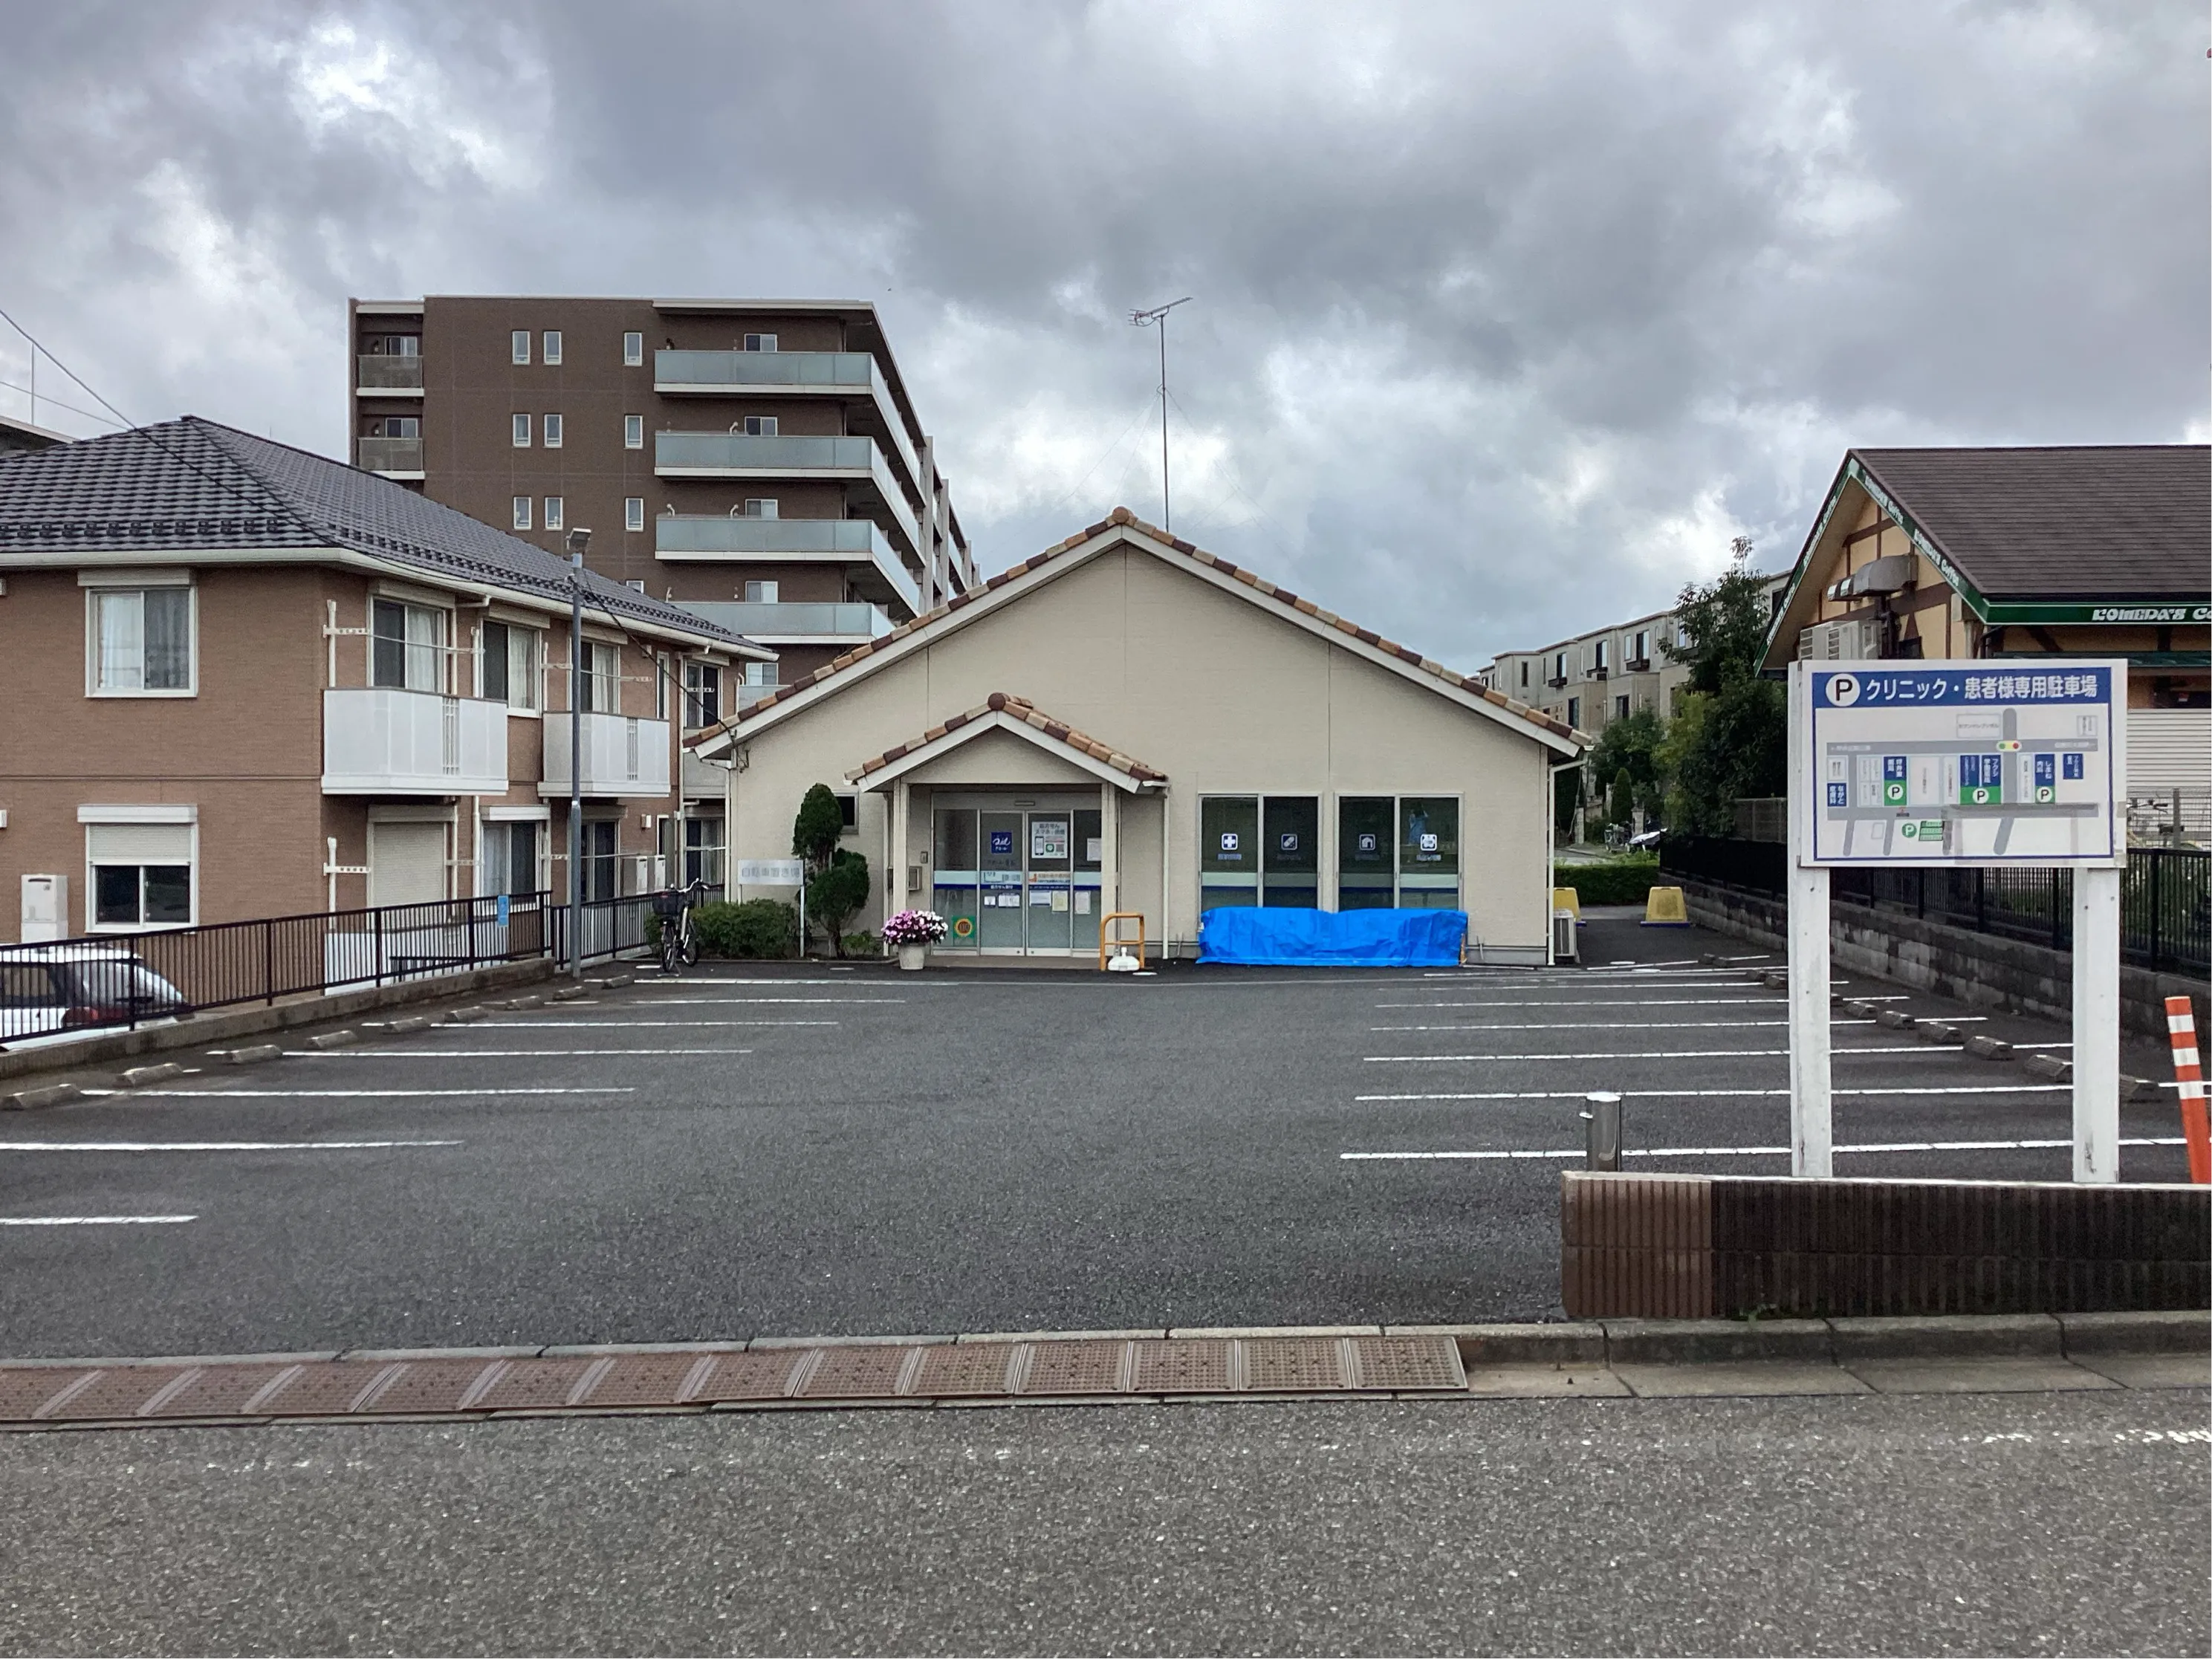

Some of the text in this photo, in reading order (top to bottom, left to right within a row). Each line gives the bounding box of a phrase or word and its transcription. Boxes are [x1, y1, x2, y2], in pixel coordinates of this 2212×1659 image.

[2092, 608, 2187, 621] KOMEDA'S
[1835, 675, 2098, 701] P クリニック・患者様専用駐車場
[1892, 787, 1900, 797] P
[1977, 790, 1985, 801] P
[2041, 789, 2049, 800] P
[1905, 825, 1915, 836] P
